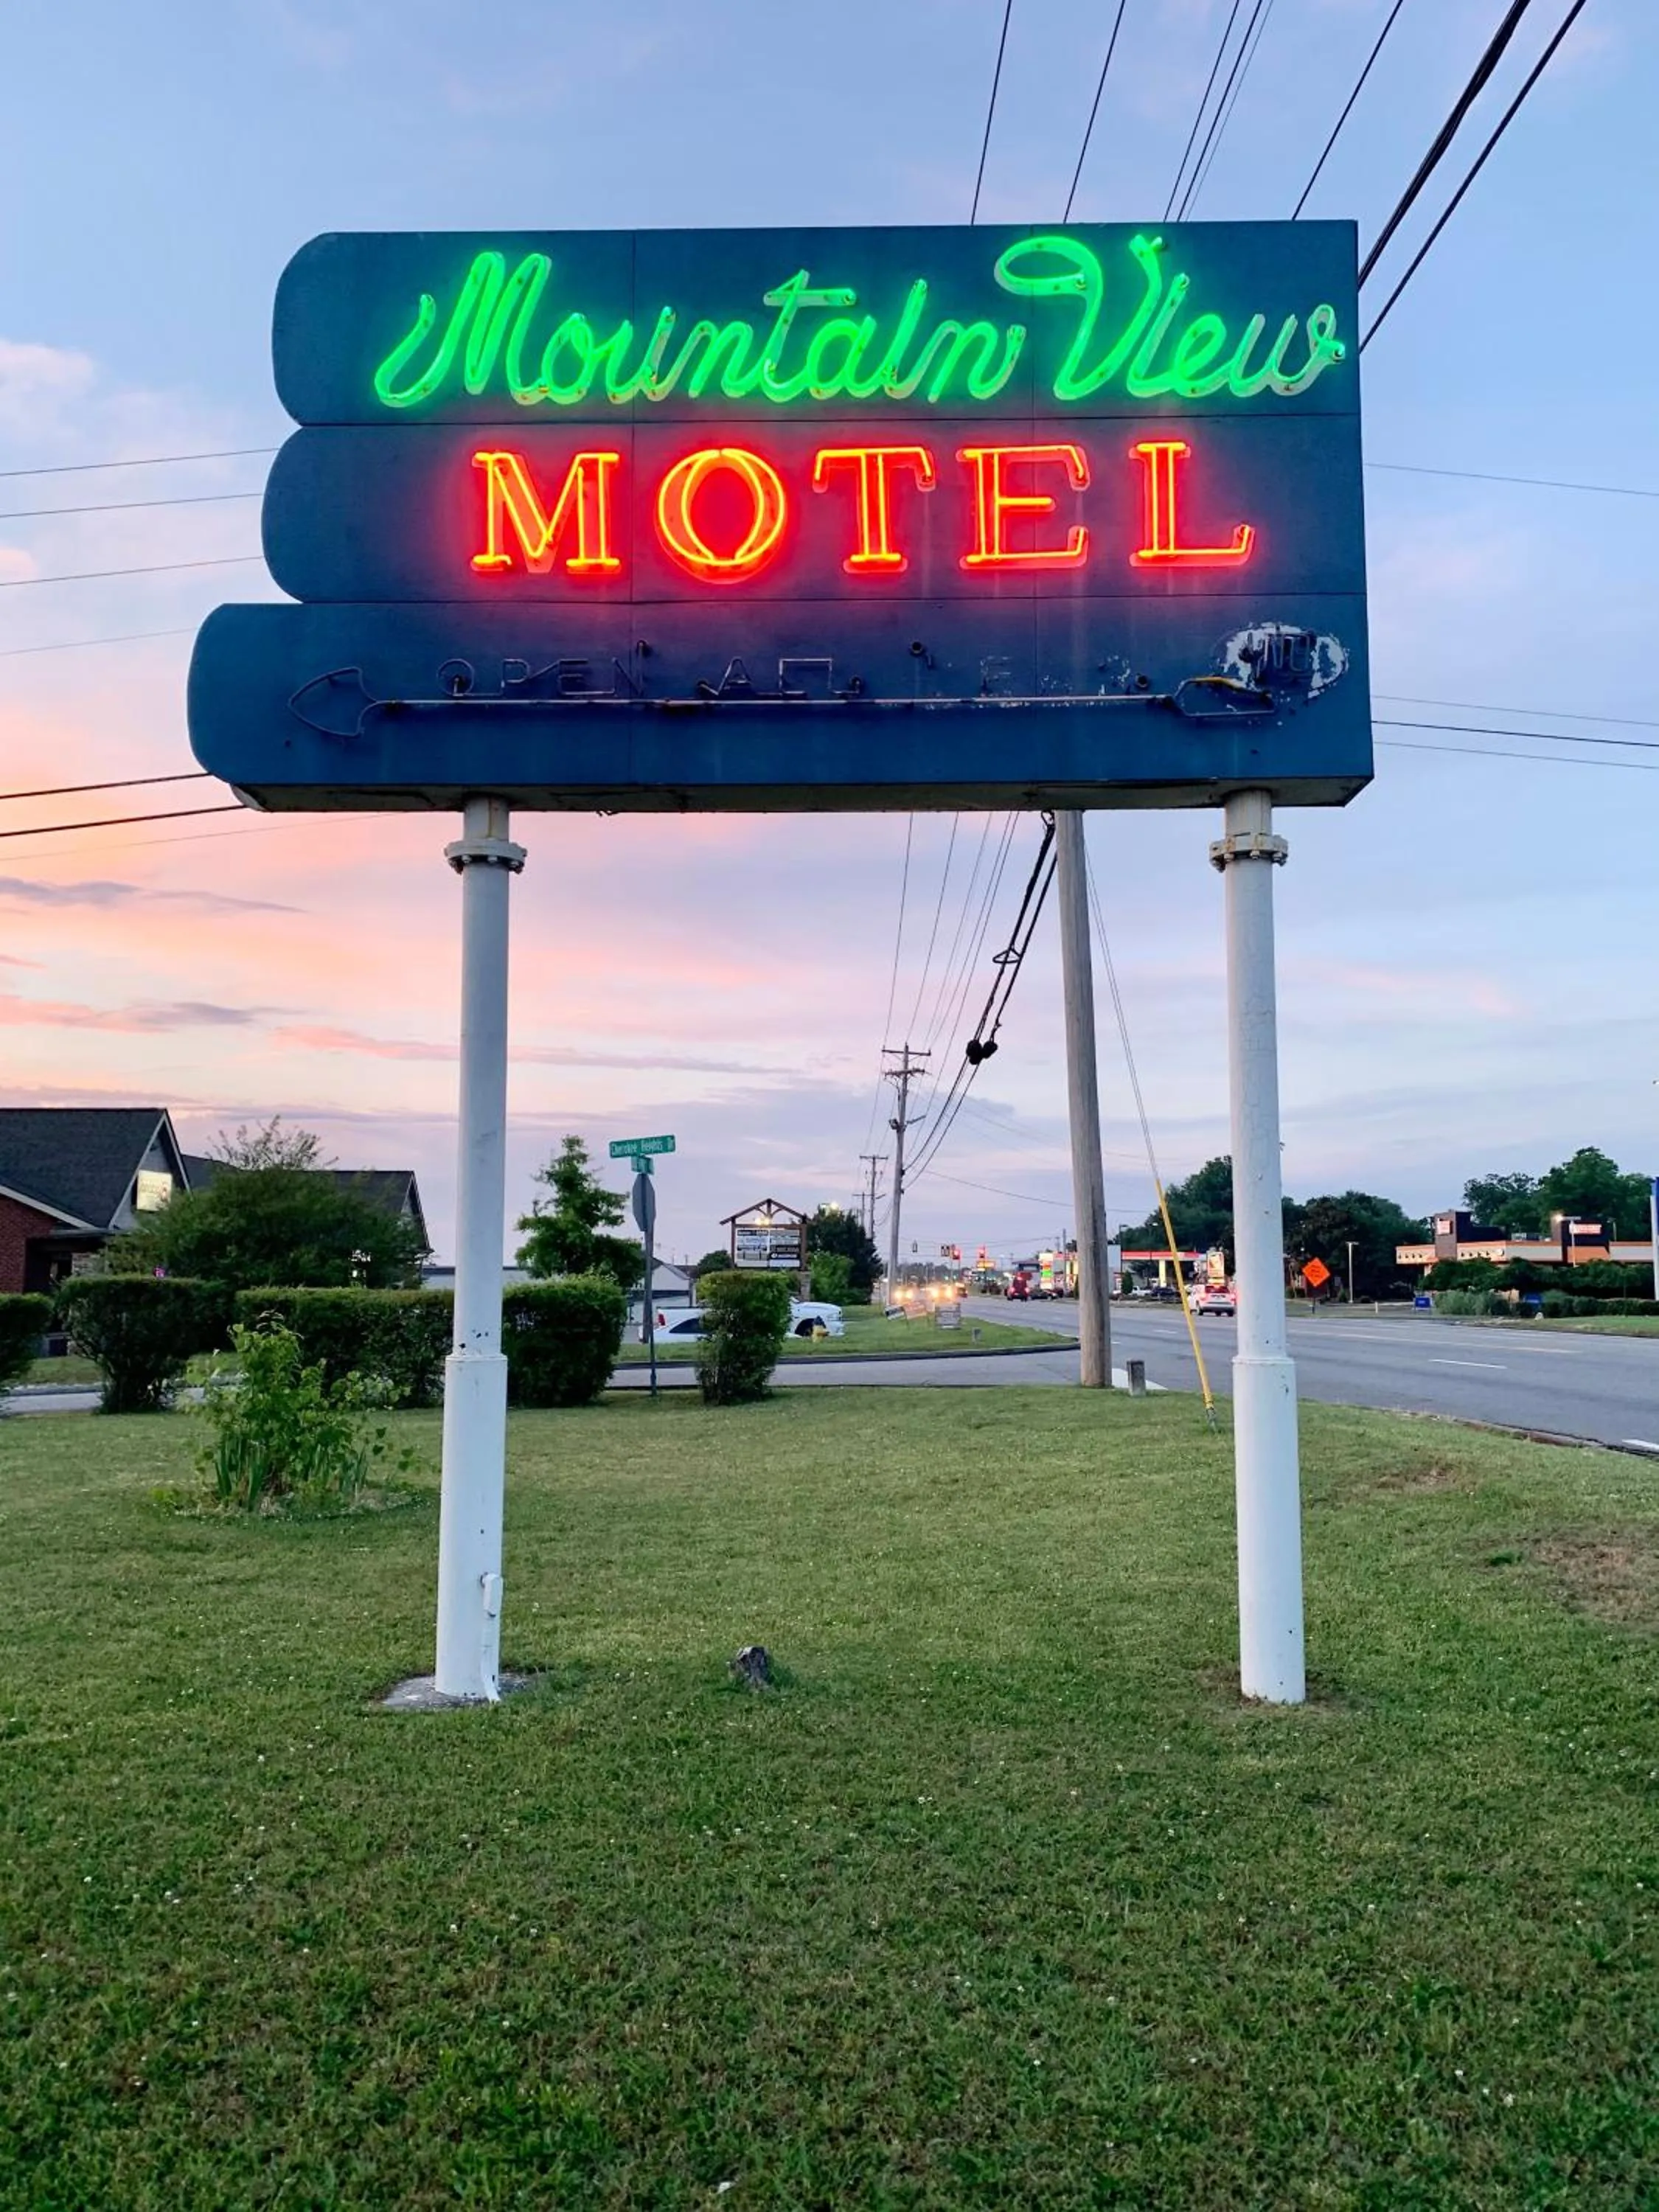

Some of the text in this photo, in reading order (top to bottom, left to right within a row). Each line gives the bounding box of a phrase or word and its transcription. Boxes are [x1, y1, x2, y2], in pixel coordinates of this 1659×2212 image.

[374, 234, 1346, 407] Mountain View
[470, 439, 1256, 584] MOTEL
[437, 658, 646, 698] OPEN
